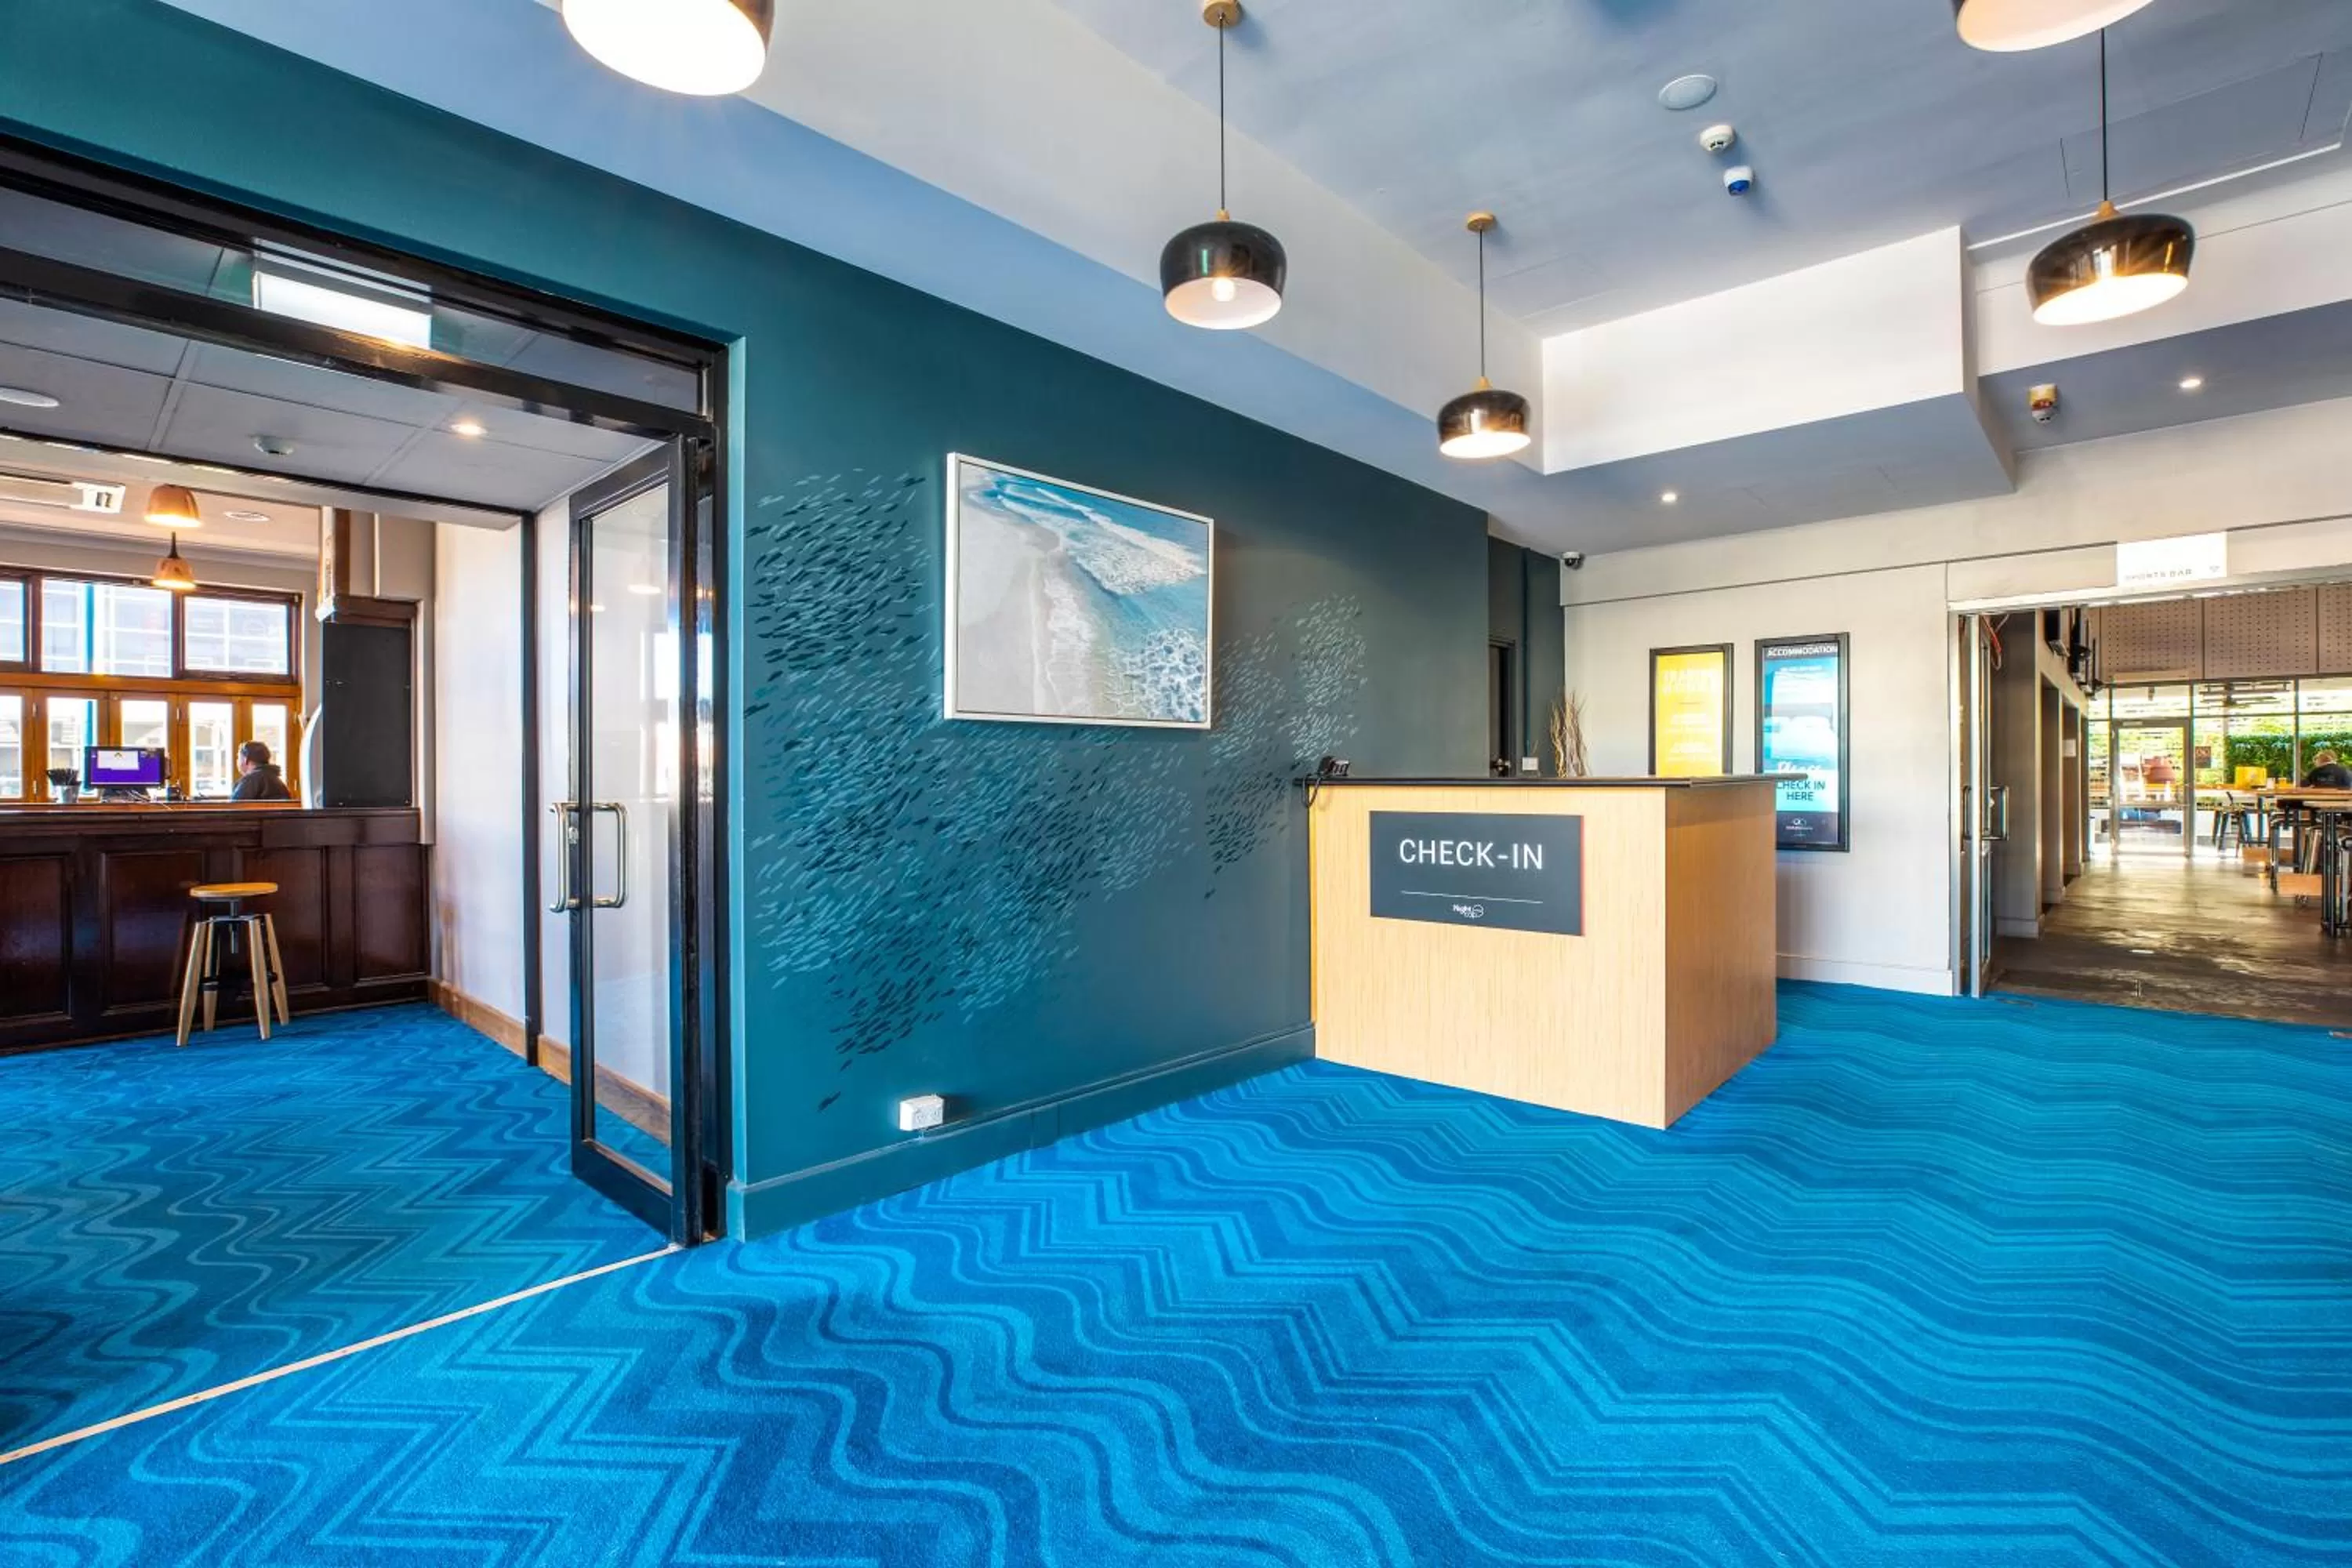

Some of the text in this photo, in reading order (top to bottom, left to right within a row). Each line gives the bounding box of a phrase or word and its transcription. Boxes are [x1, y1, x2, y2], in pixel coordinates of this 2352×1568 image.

[1813, 781, 1826, 790] IN
[1786, 791, 1814, 801] HERE
[1399, 839, 1543, 869] CHECK-IN
